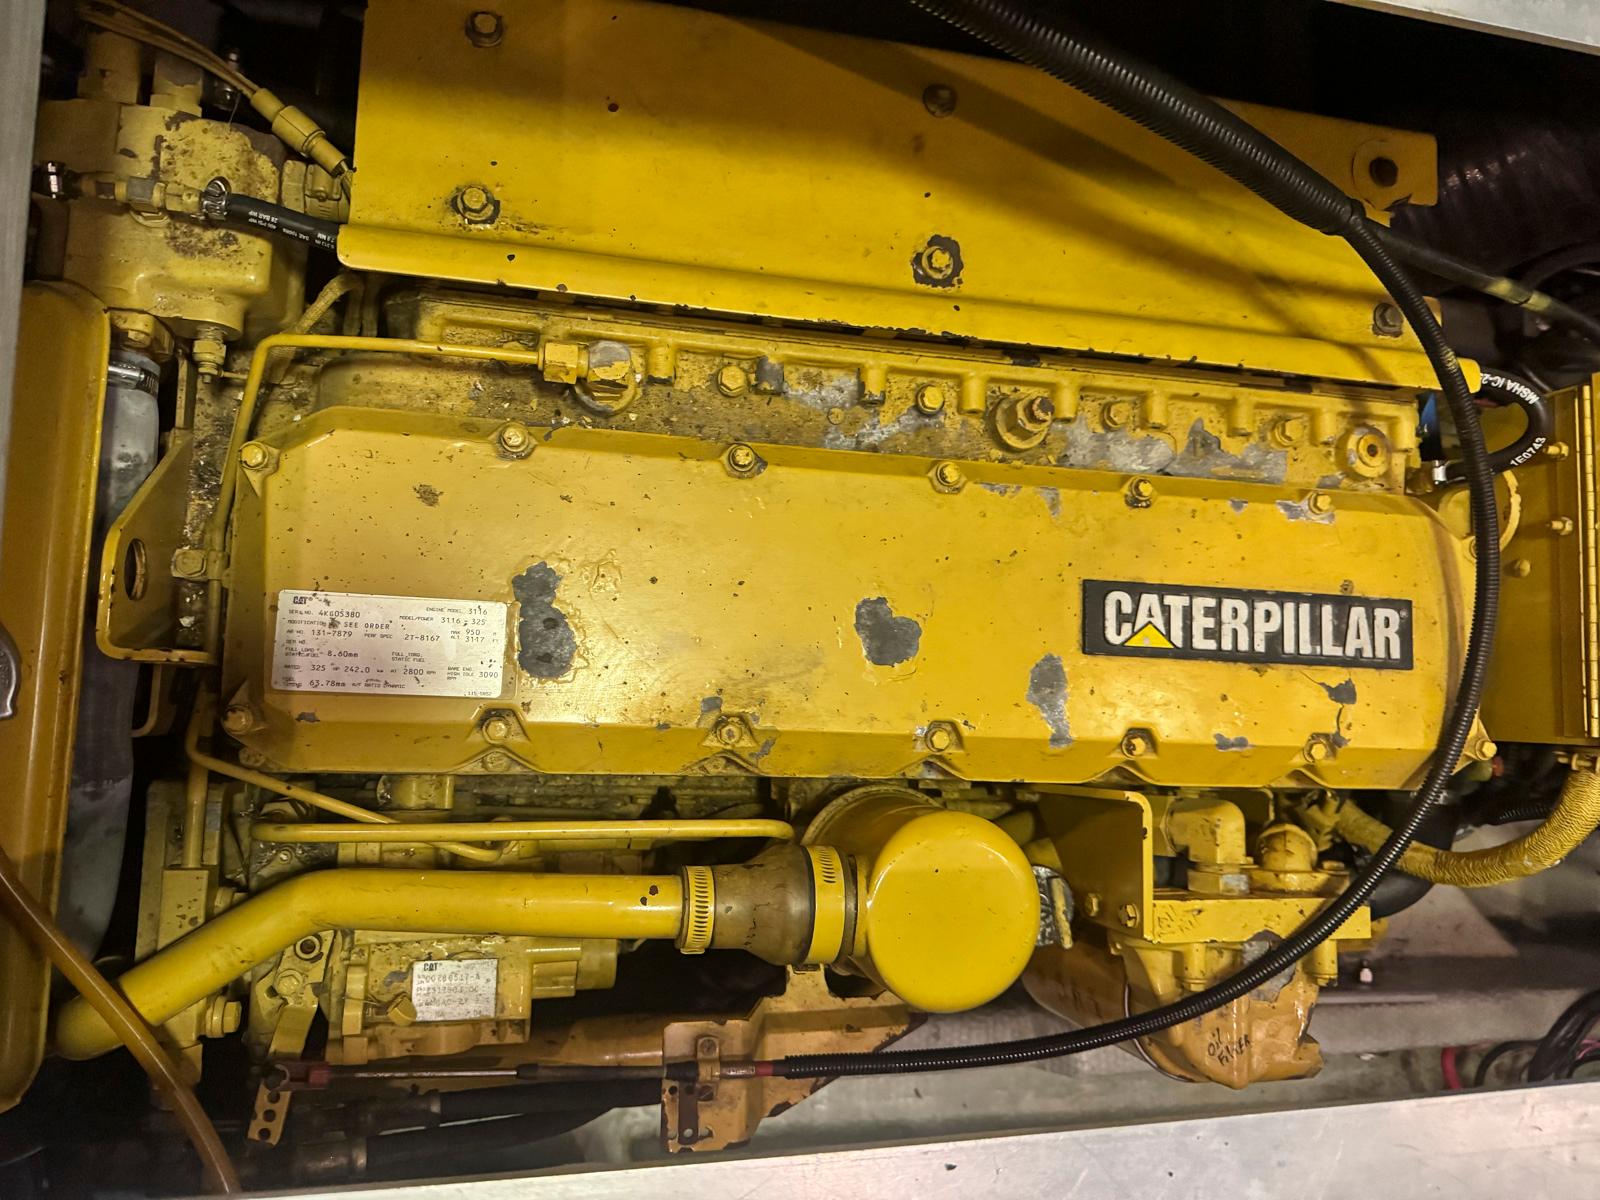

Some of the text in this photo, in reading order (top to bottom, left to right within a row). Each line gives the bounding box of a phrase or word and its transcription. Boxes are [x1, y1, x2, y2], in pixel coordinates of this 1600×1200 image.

[259, 213, 271, 221] BAR
[298, 232, 310, 241] SAE
[317, 232, 327, 240] MM
[1506, 380, 1540, 404] MSHA
[1510, 437, 1546, 466] 1E0743
[293, 595, 308, 604] CAT
[1104, 590, 1400, 659] CATERPILLAR
[312, 630, 353, 638] 131-7879
[328, 650, 358, 658] 8.60mm
[310, 680, 346, 688] 63.78mm
[424, 962, 438, 972] CAT
